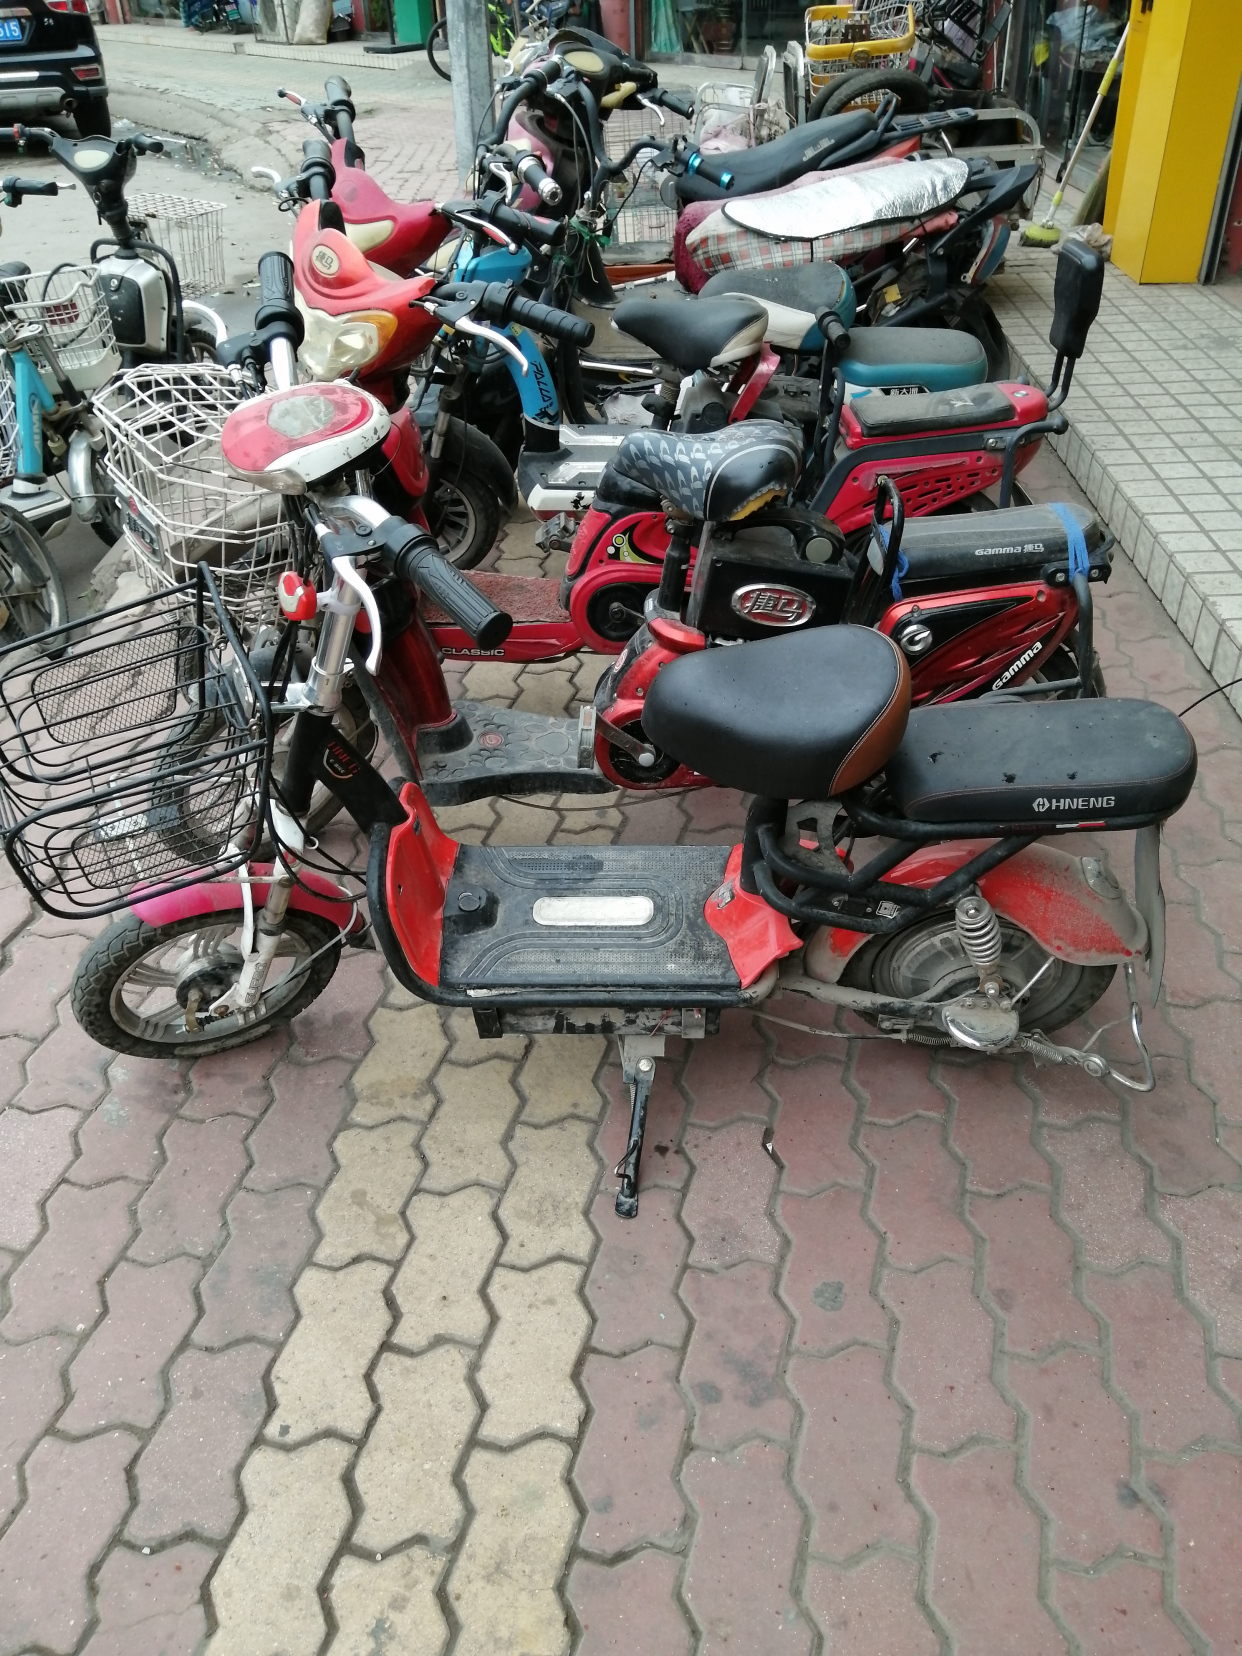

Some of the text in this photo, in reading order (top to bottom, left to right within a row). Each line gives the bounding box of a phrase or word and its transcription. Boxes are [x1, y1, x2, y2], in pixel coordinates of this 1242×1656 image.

[975, 546, 1021, 556] Gamma
[743, 591, 803, 621] 捷马
[992, 641, 1043, 691] Gamma
[1051, 796, 1116, 810] HNENG
